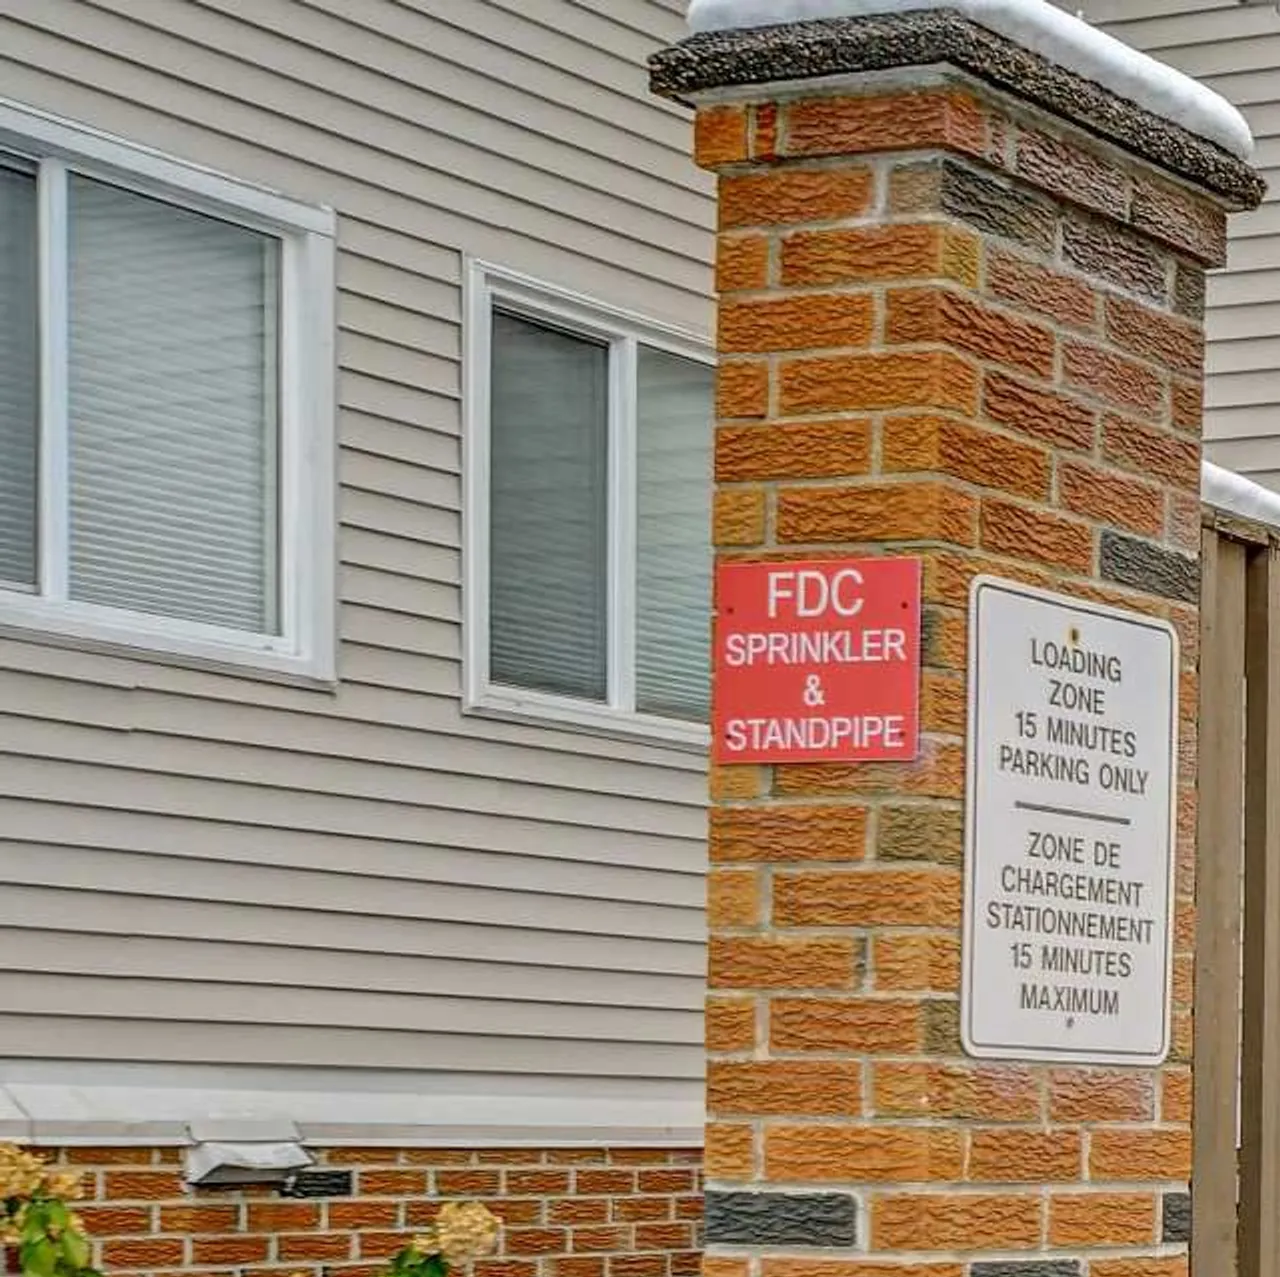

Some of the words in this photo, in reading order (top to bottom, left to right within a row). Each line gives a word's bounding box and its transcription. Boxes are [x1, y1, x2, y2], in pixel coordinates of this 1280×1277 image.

[766, 569, 864, 619] FDC
[725, 628, 907, 667] SPRINKLER
[1030, 638, 1123, 683] LOADING
[803, 674, 826, 706] &
[1048, 679, 1106, 715] ZONE
[725, 714, 905, 752] STANDPIPE
[1015, 711, 1038, 740] 15
[1046, 715, 1138, 758] MINUTES
[999, 745, 1091, 786] PARKING
[1099, 761, 1150, 797] ONLY
[1027, 832, 1085, 866] ZONE
[1094, 840, 1122, 870] DE
[1001, 866, 1144, 908] CHARGEMENT
[986, 903, 1157, 946] STATIONNEMENT
[1010, 942, 1032, 970] 15
[1042, 946, 1133, 979] MINUTES
[1020, 984, 1120, 1016] MAXIMUM
